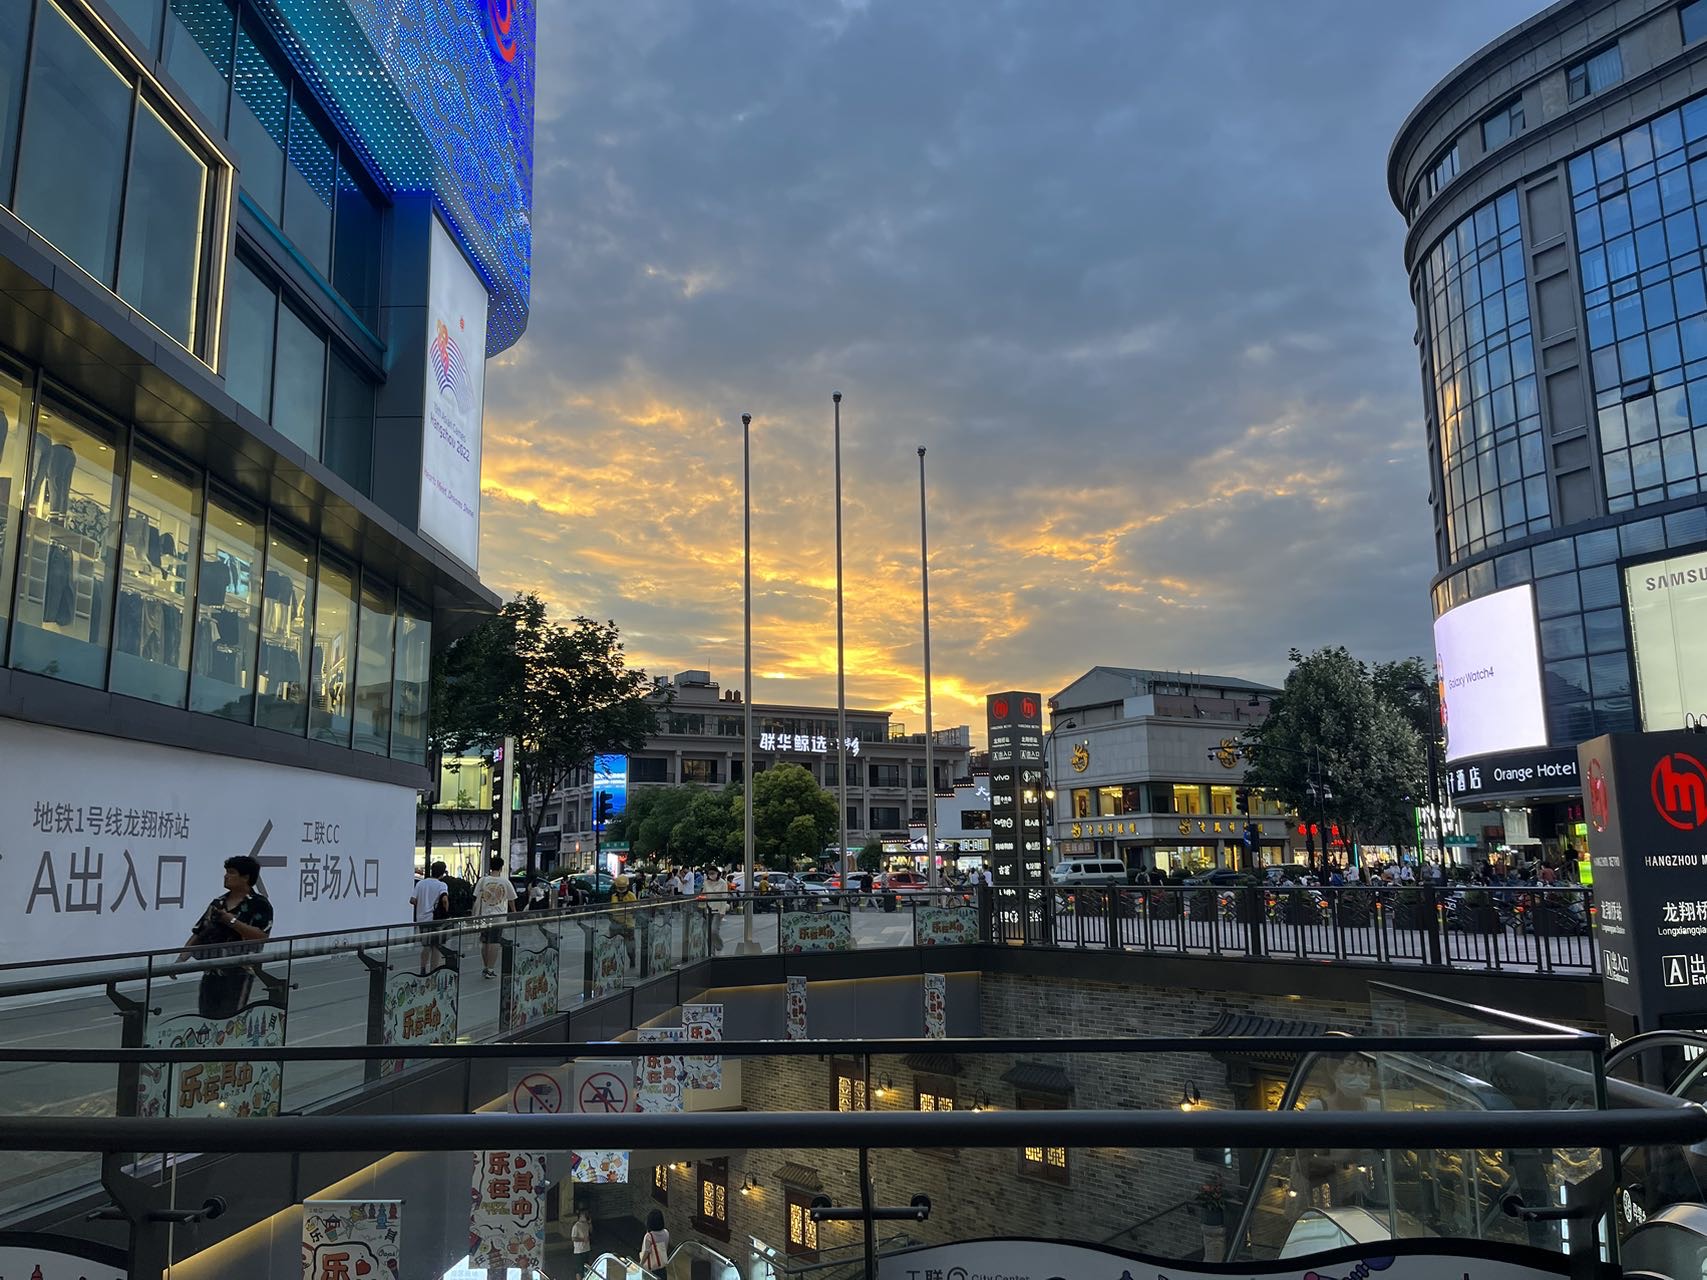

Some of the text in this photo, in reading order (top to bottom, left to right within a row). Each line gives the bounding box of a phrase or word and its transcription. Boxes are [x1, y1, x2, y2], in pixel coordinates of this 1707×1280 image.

[430, 411, 470, 462] Hangzhou 2022
[1448, 666, 1494, 690] Galaxy Watch4
[1493, 761, 1577, 782] Orange Hotel
[33, 800, 190, 839] 地铁1号线龙翔桥站
[301, 821, 340, 844] 工联CC
[1645, 855, 1698, 867] HANGZHOU
[25, 846, 187, 914] A出入口
[299, 852, 379, 902] 商场入口
[1670, 958, 1684, 983] A
[1692, 975, 1707, 985] En
